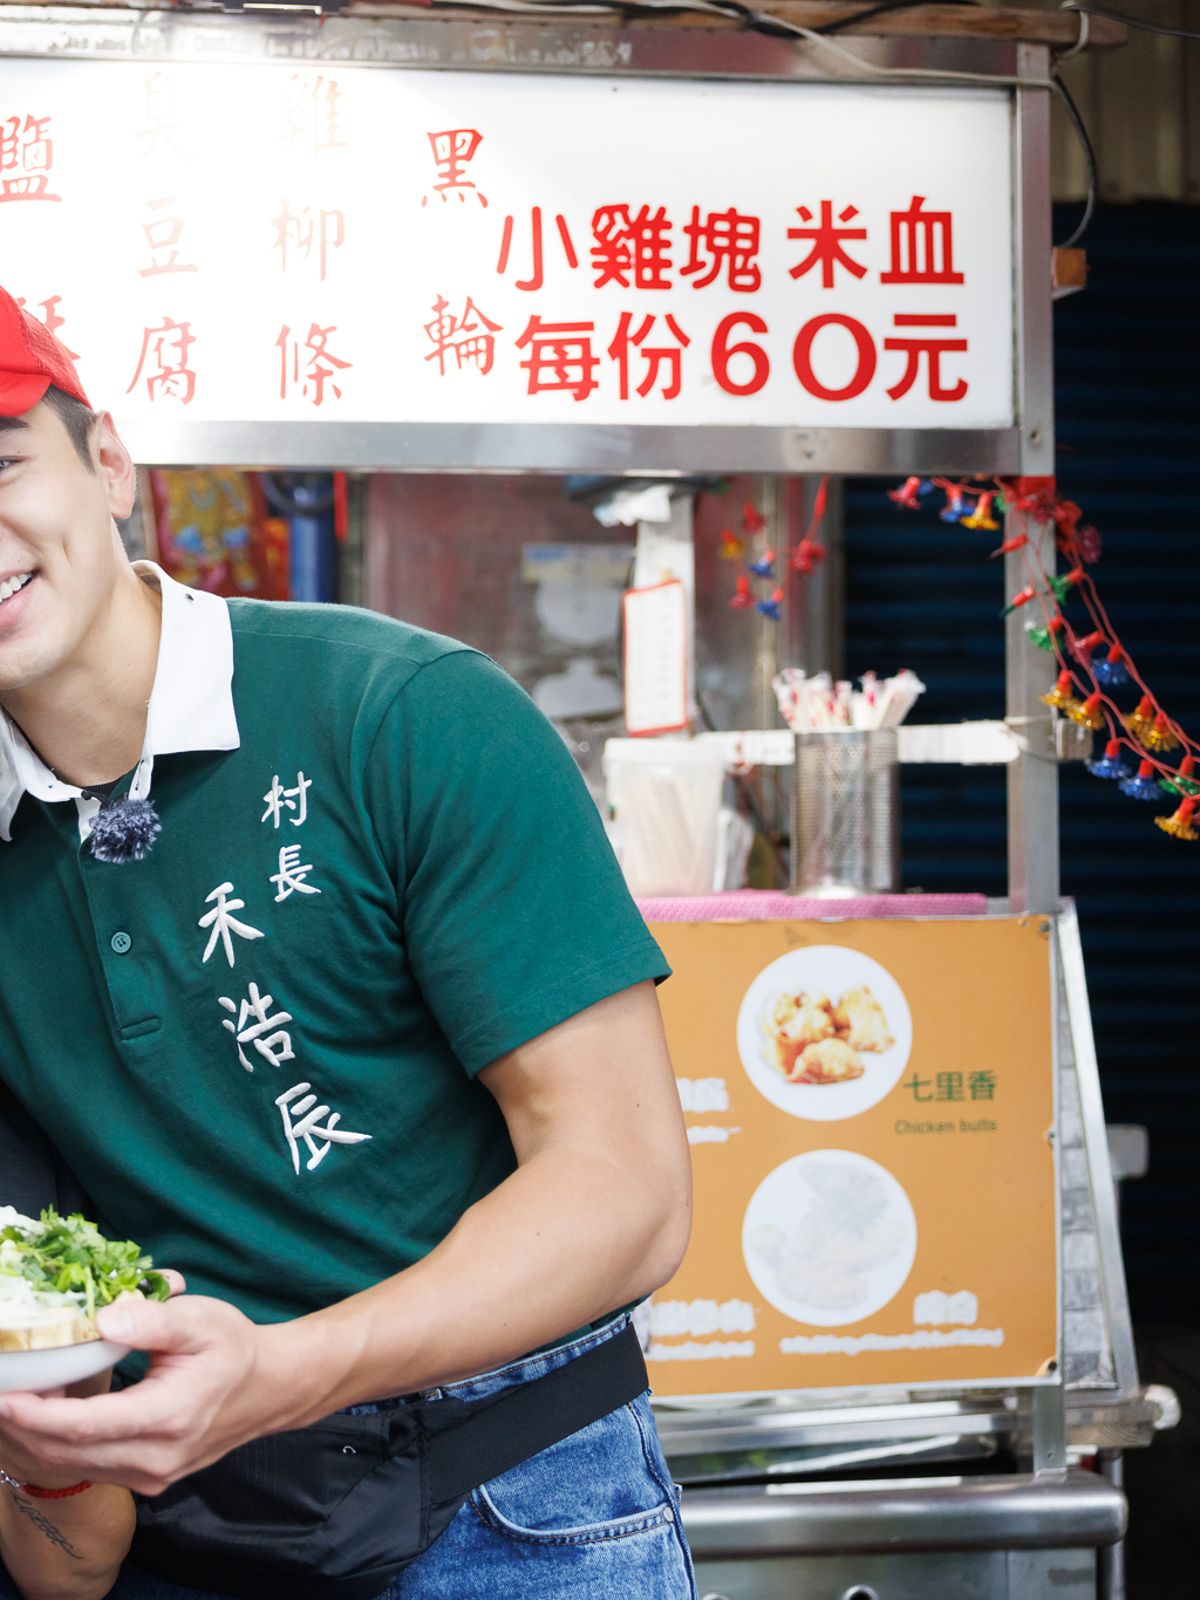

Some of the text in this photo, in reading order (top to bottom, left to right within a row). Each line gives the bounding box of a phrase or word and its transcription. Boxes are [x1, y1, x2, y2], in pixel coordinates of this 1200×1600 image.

[125, 70, 199, 406] 臭豆腐
[271, 74, 354, 407] 雞柳條
[420, 128, 504, 377] 黑輪
[496, 195, 966, 293] 小雞塊 米血
[261, 771, 322, 903] 村長
[198, 881, 373, 1175] 禾浩辰
[903, 1070, 996, 1102] 七里香
